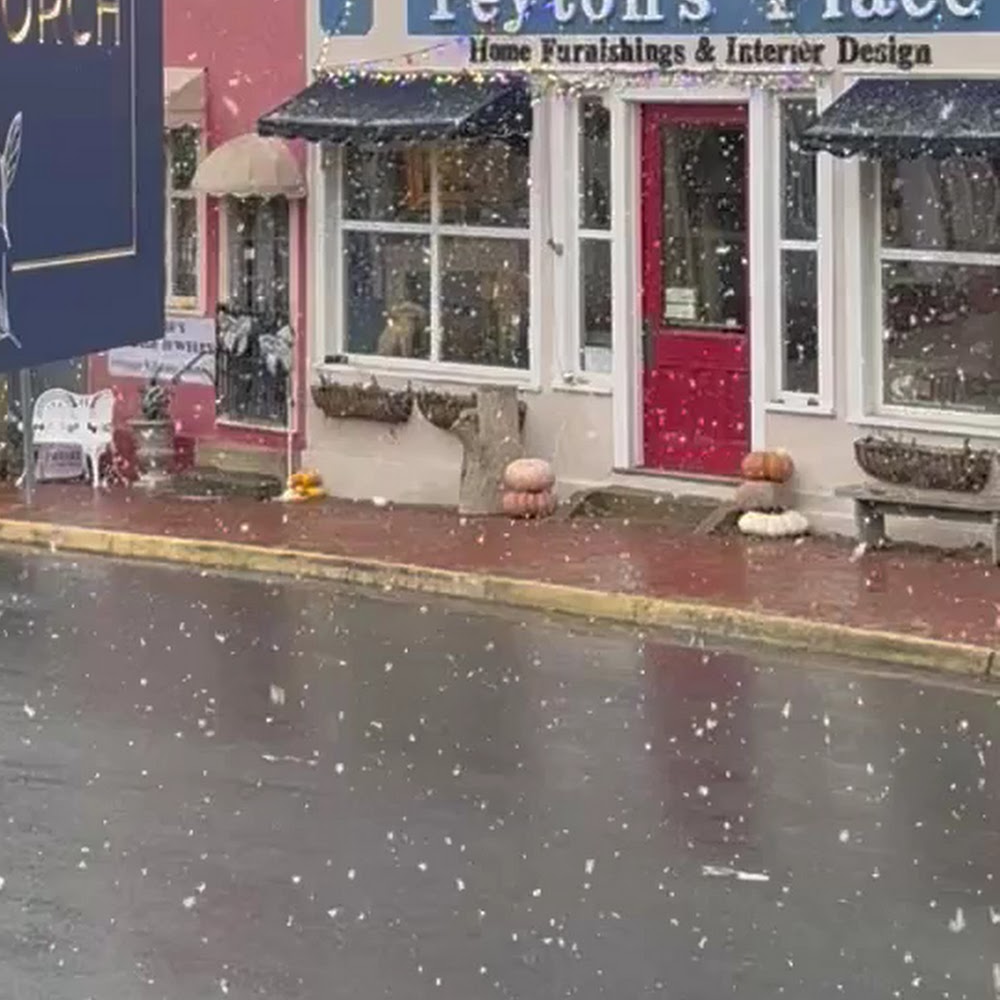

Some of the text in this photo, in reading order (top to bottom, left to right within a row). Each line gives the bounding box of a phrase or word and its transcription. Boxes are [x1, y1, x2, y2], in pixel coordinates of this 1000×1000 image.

[469, 34, 933, 68] Home Furnishings & Interior Design
